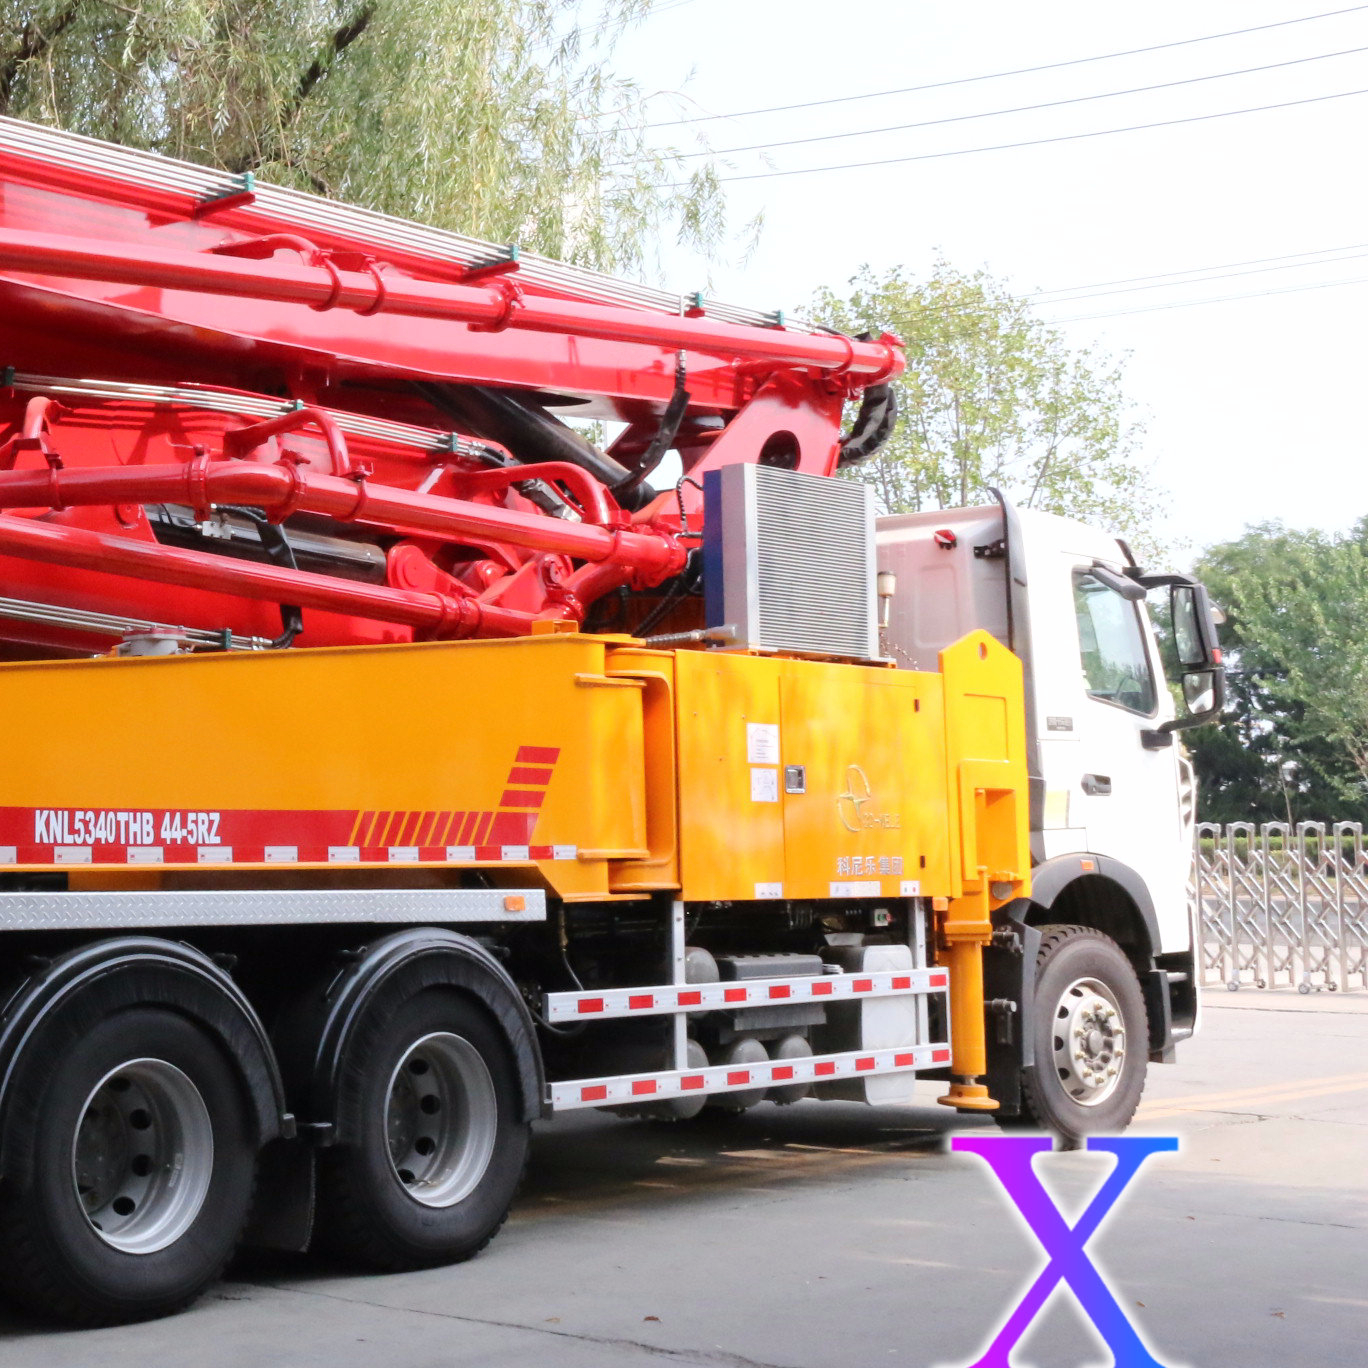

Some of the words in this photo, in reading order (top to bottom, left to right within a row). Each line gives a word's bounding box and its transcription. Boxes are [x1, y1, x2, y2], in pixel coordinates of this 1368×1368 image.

[34, 809, 155, 845] KNL5340THB
[160, 811, 222, 845] 44-5RZ
[837, 855, 903, 876] 科尼乐集团
